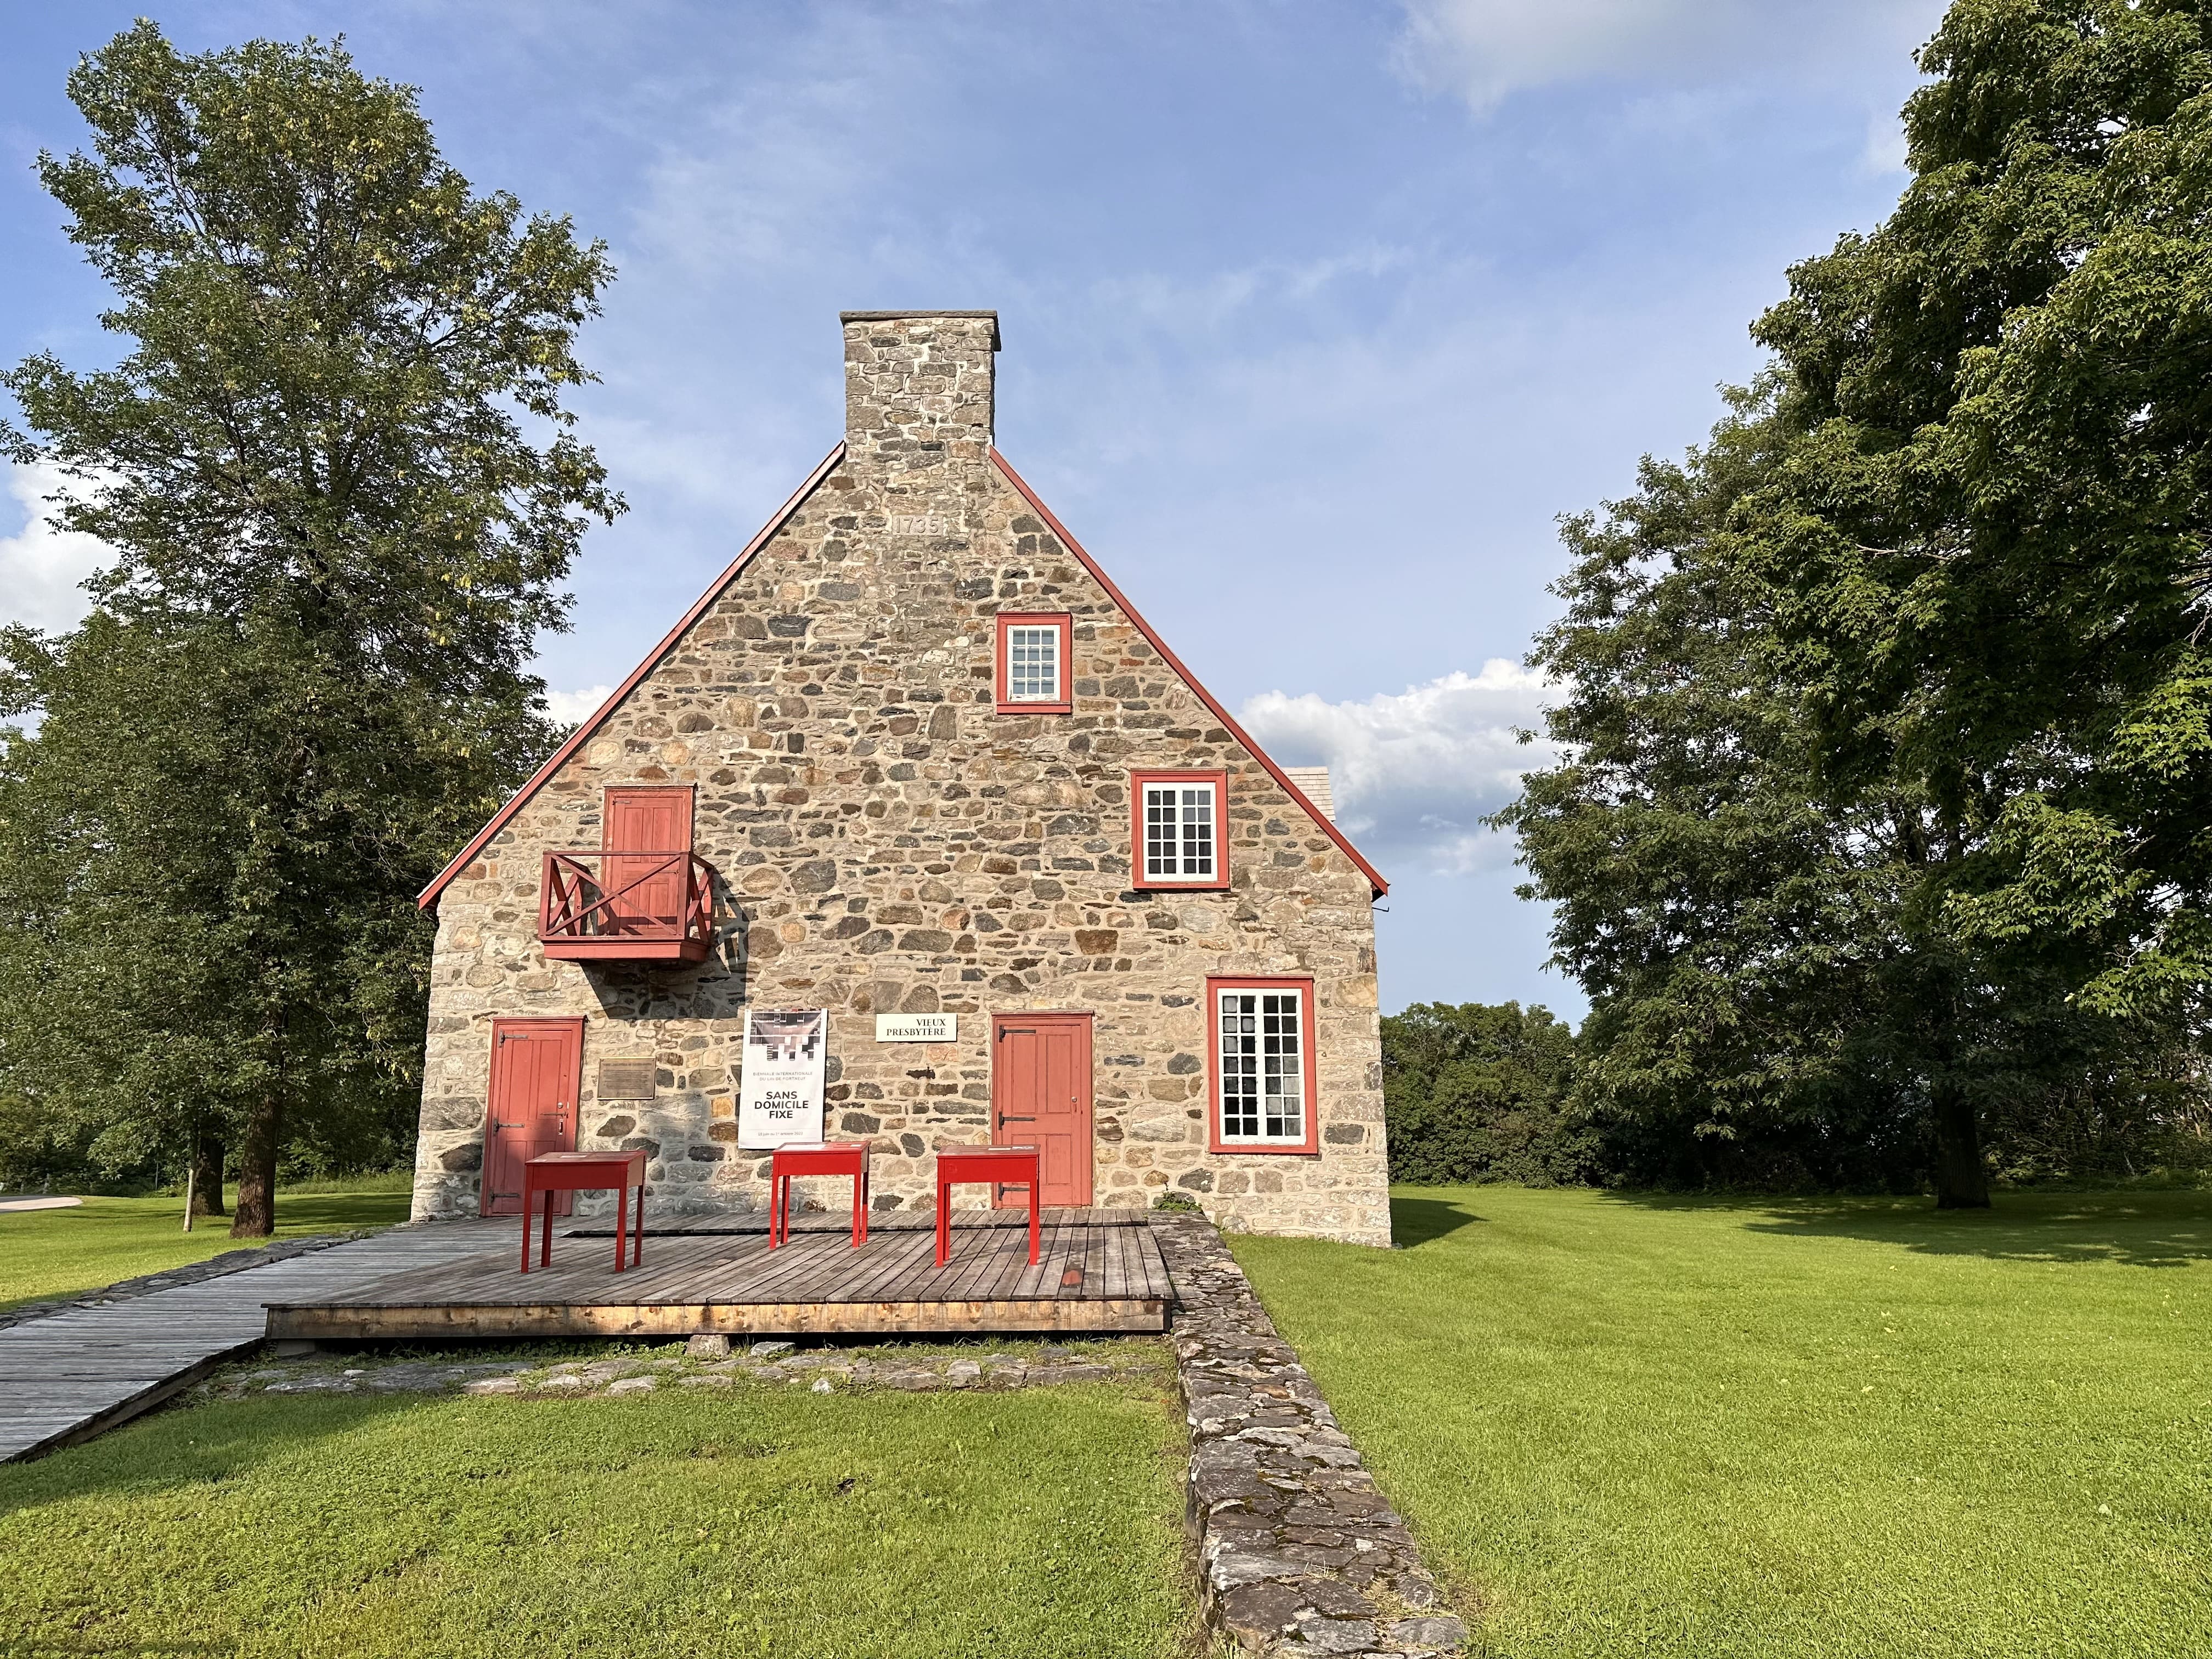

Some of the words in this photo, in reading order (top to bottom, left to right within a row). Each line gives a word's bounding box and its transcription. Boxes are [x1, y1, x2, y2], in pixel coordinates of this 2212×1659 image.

[895, 517, 939, 533] 1735
[887, 1026, 946, 1036] PRESBYTÈRE
[766, 1091, 797, 1099] SANS
[755, 1101, 809, 1109] DOMICILE
[769, 1110, 793, 1119] FIXE
